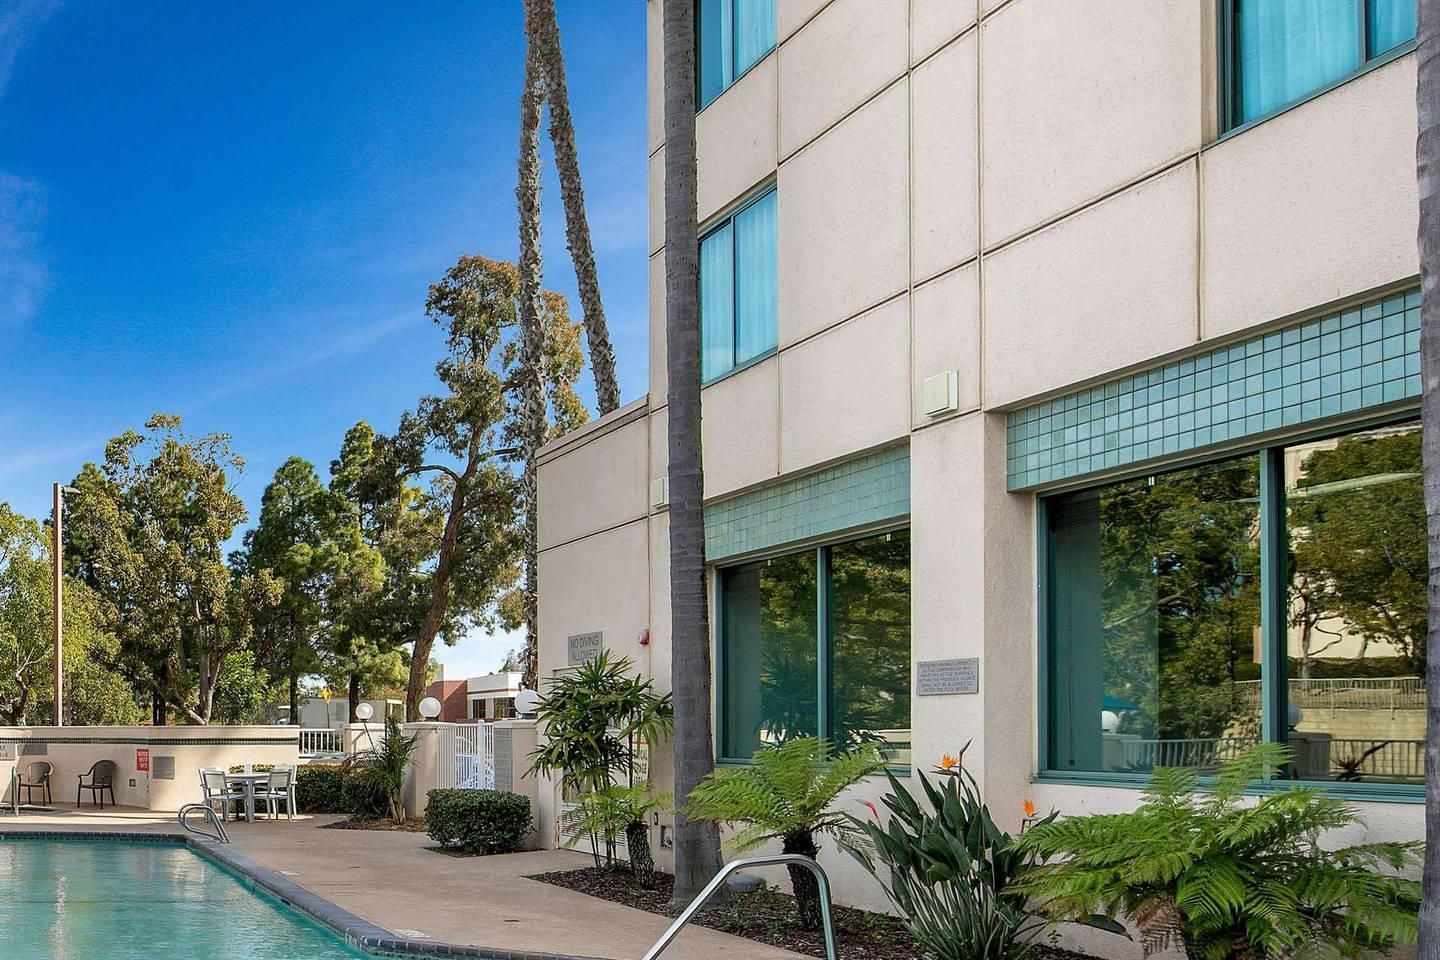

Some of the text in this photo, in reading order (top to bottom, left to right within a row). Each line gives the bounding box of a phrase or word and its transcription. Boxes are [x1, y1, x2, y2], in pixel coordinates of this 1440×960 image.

[570, 636, 599, 649] NO DIVING
[572, 649, 598, 661] ALLOWED
